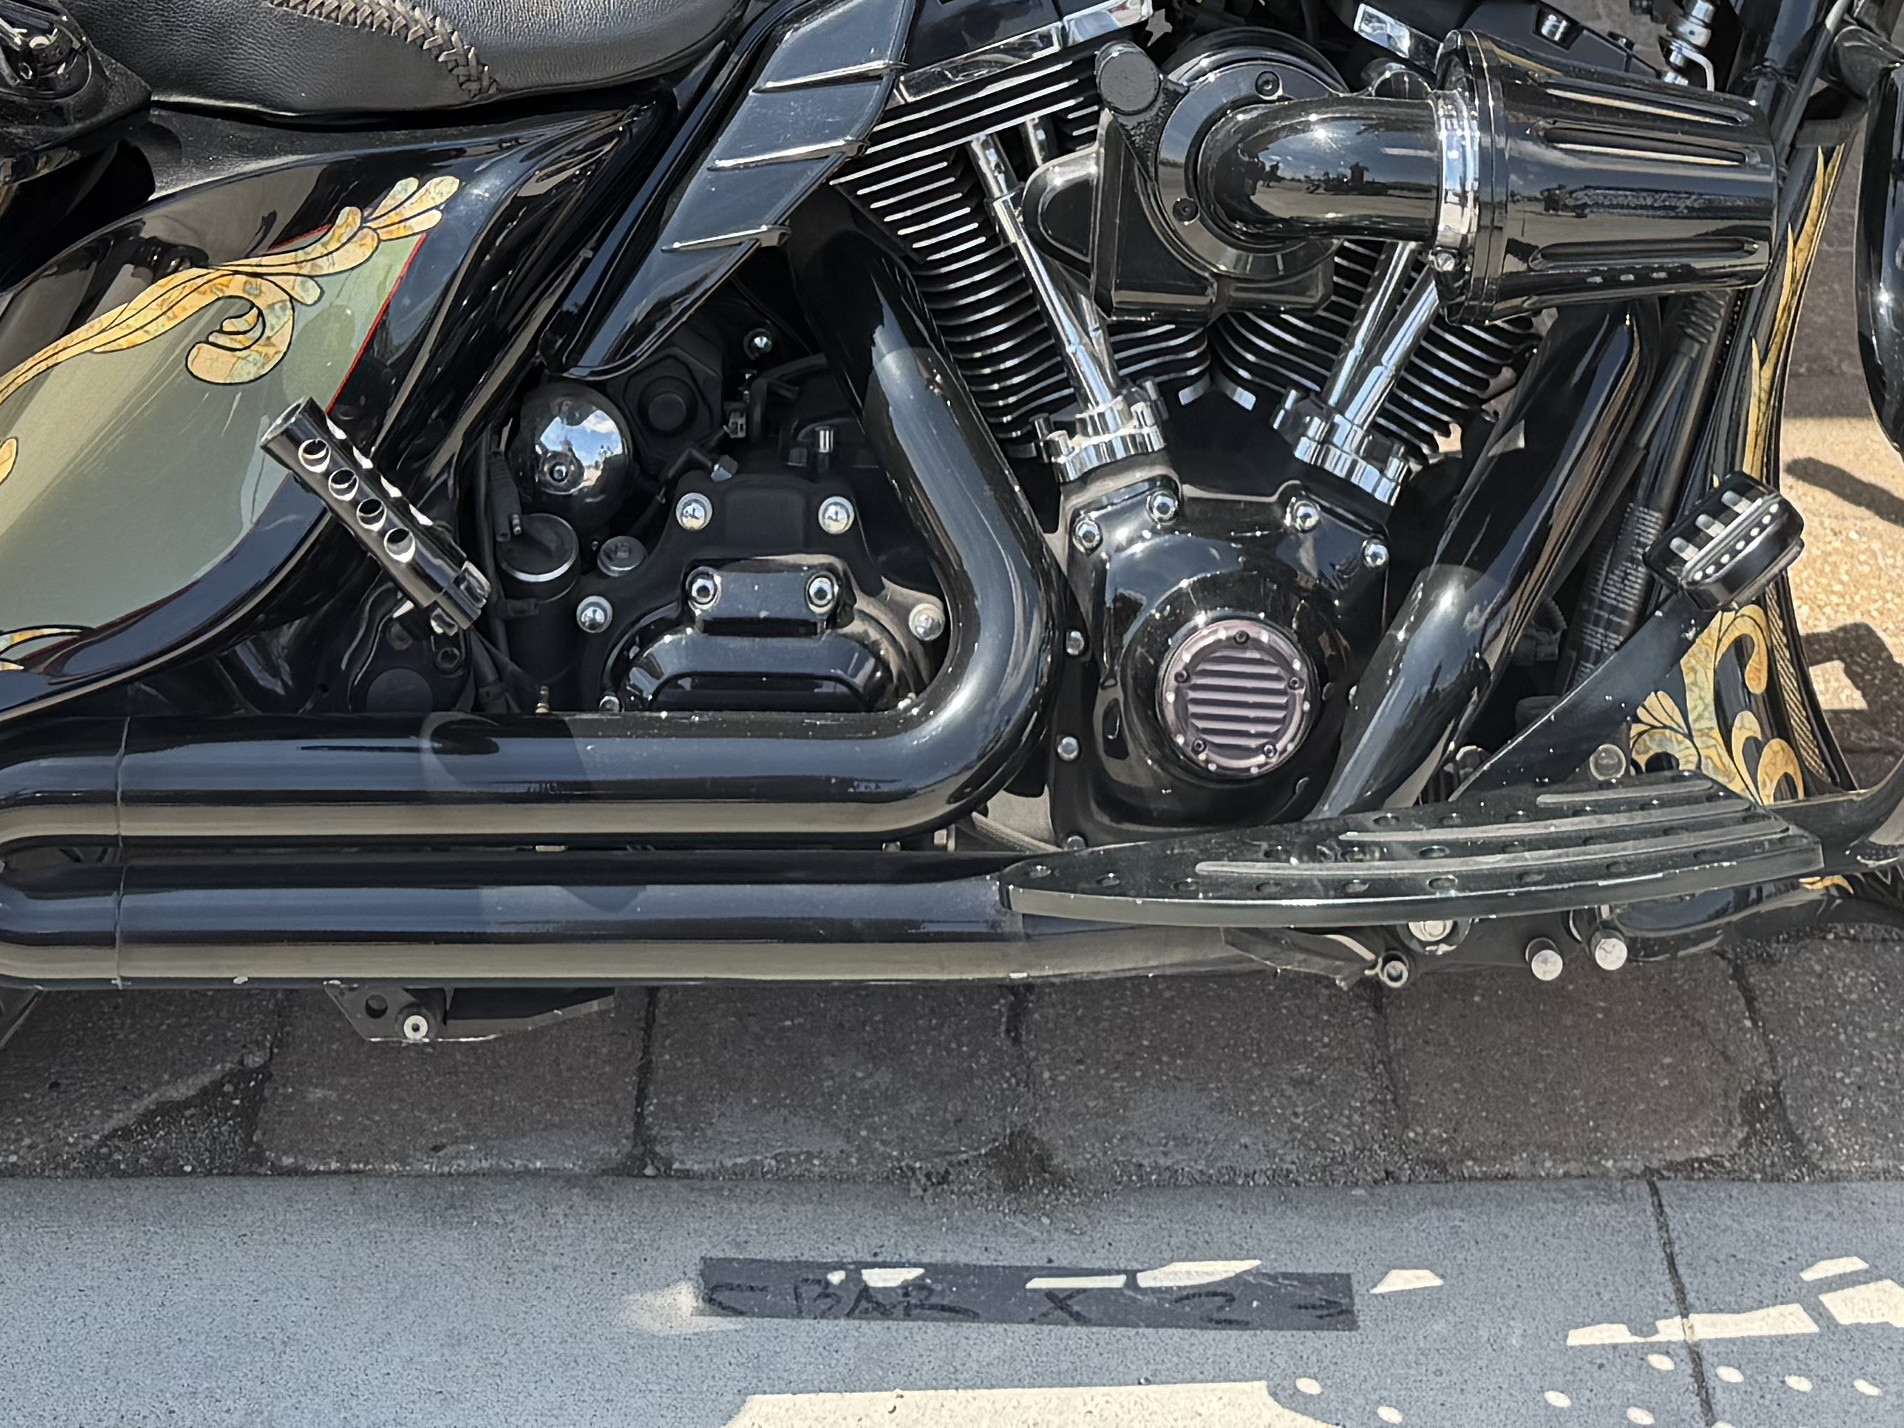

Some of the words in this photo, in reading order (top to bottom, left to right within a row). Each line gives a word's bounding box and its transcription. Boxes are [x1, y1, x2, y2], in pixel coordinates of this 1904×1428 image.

[794, 1278, 981, 1319] BAR
[1030, 1288, 1092, 1324] X
[1173, 1289, 1250, 1327] 2
